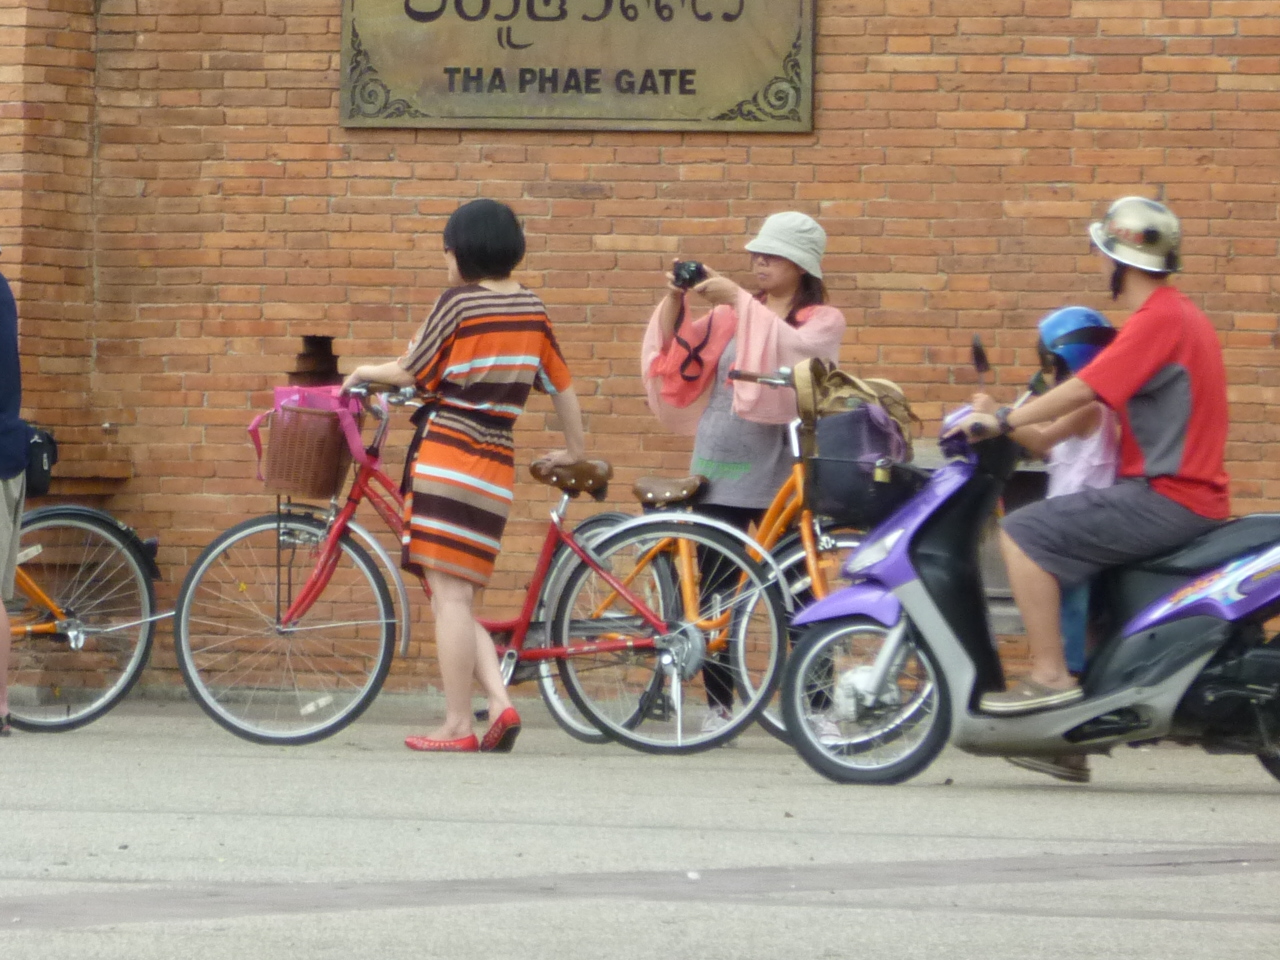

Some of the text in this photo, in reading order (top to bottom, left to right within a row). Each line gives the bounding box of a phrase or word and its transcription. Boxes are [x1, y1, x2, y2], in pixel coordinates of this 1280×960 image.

[444, 67, 696, 95] THA PHAE GATE
